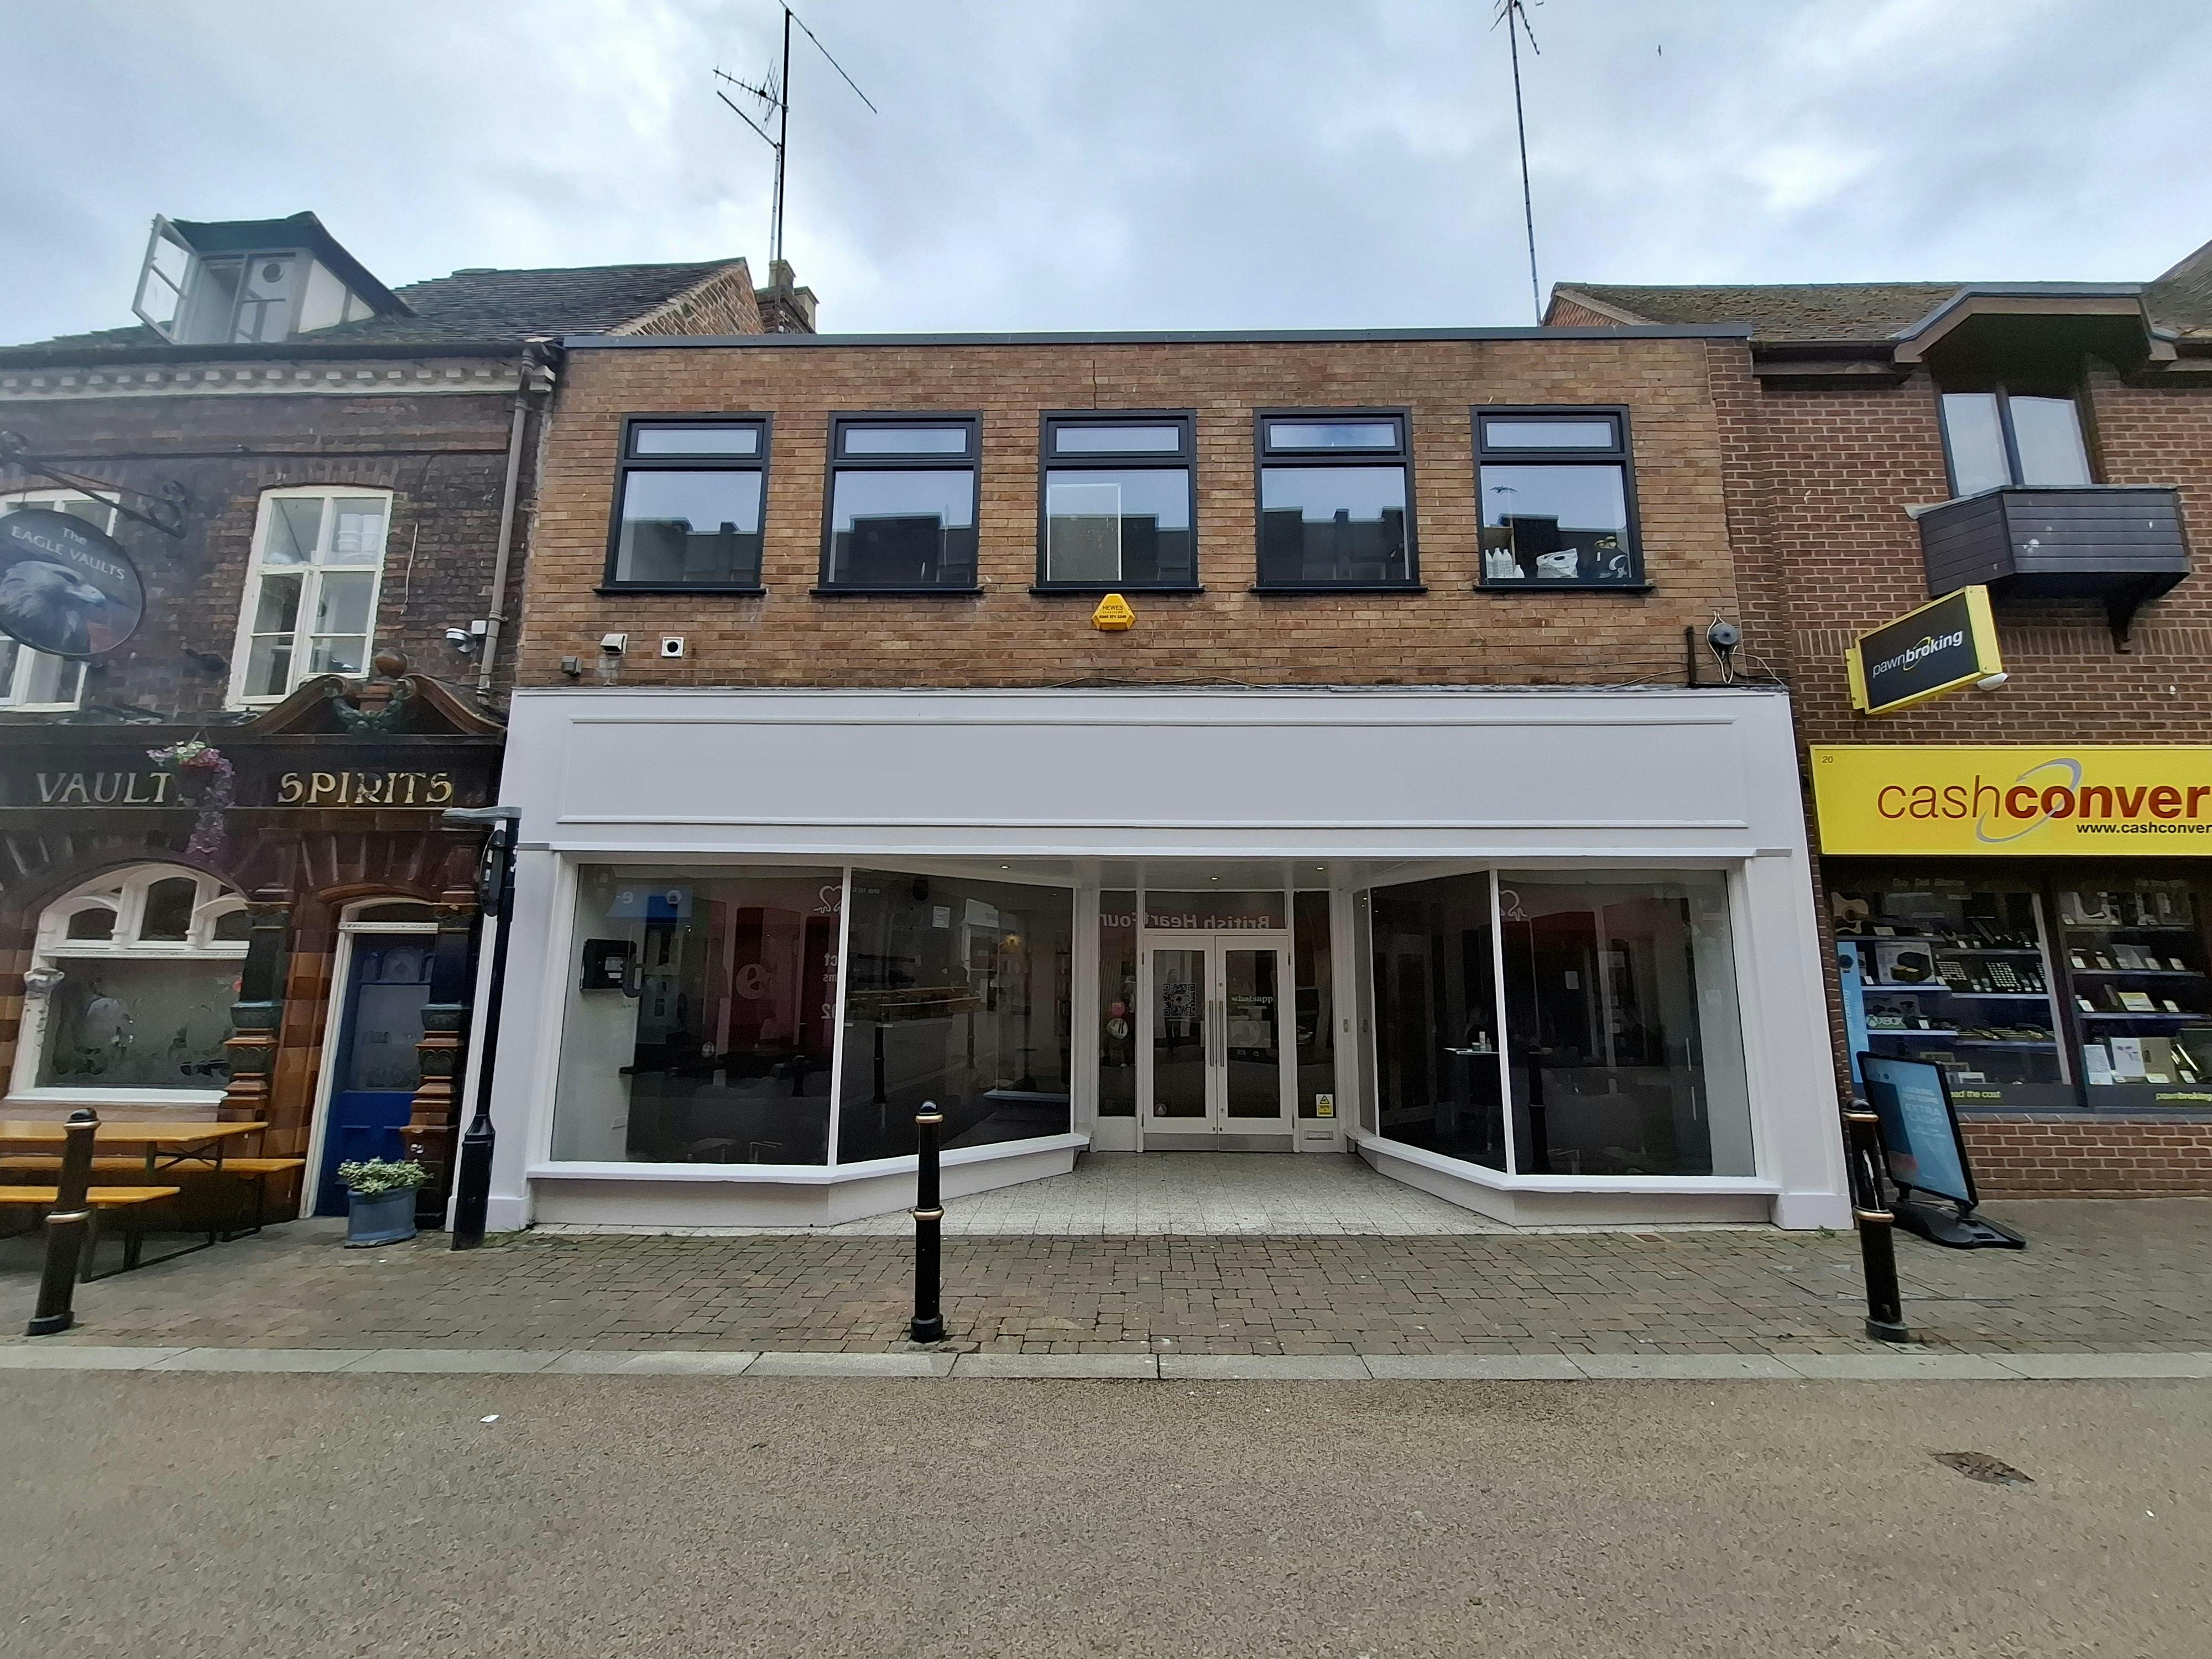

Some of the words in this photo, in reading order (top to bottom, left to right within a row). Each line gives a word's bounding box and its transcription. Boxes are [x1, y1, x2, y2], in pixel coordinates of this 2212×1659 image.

[11, 525, 65, 556] EAGLE
[70, 549, 126, 580] VAULTS
[62, 527, 87, 546] The
[1872, 630, 1963, 679] pawnbroking
[35, 773, 184, 803] VAULT
[277, 771, 452, 804] SPIRITS
